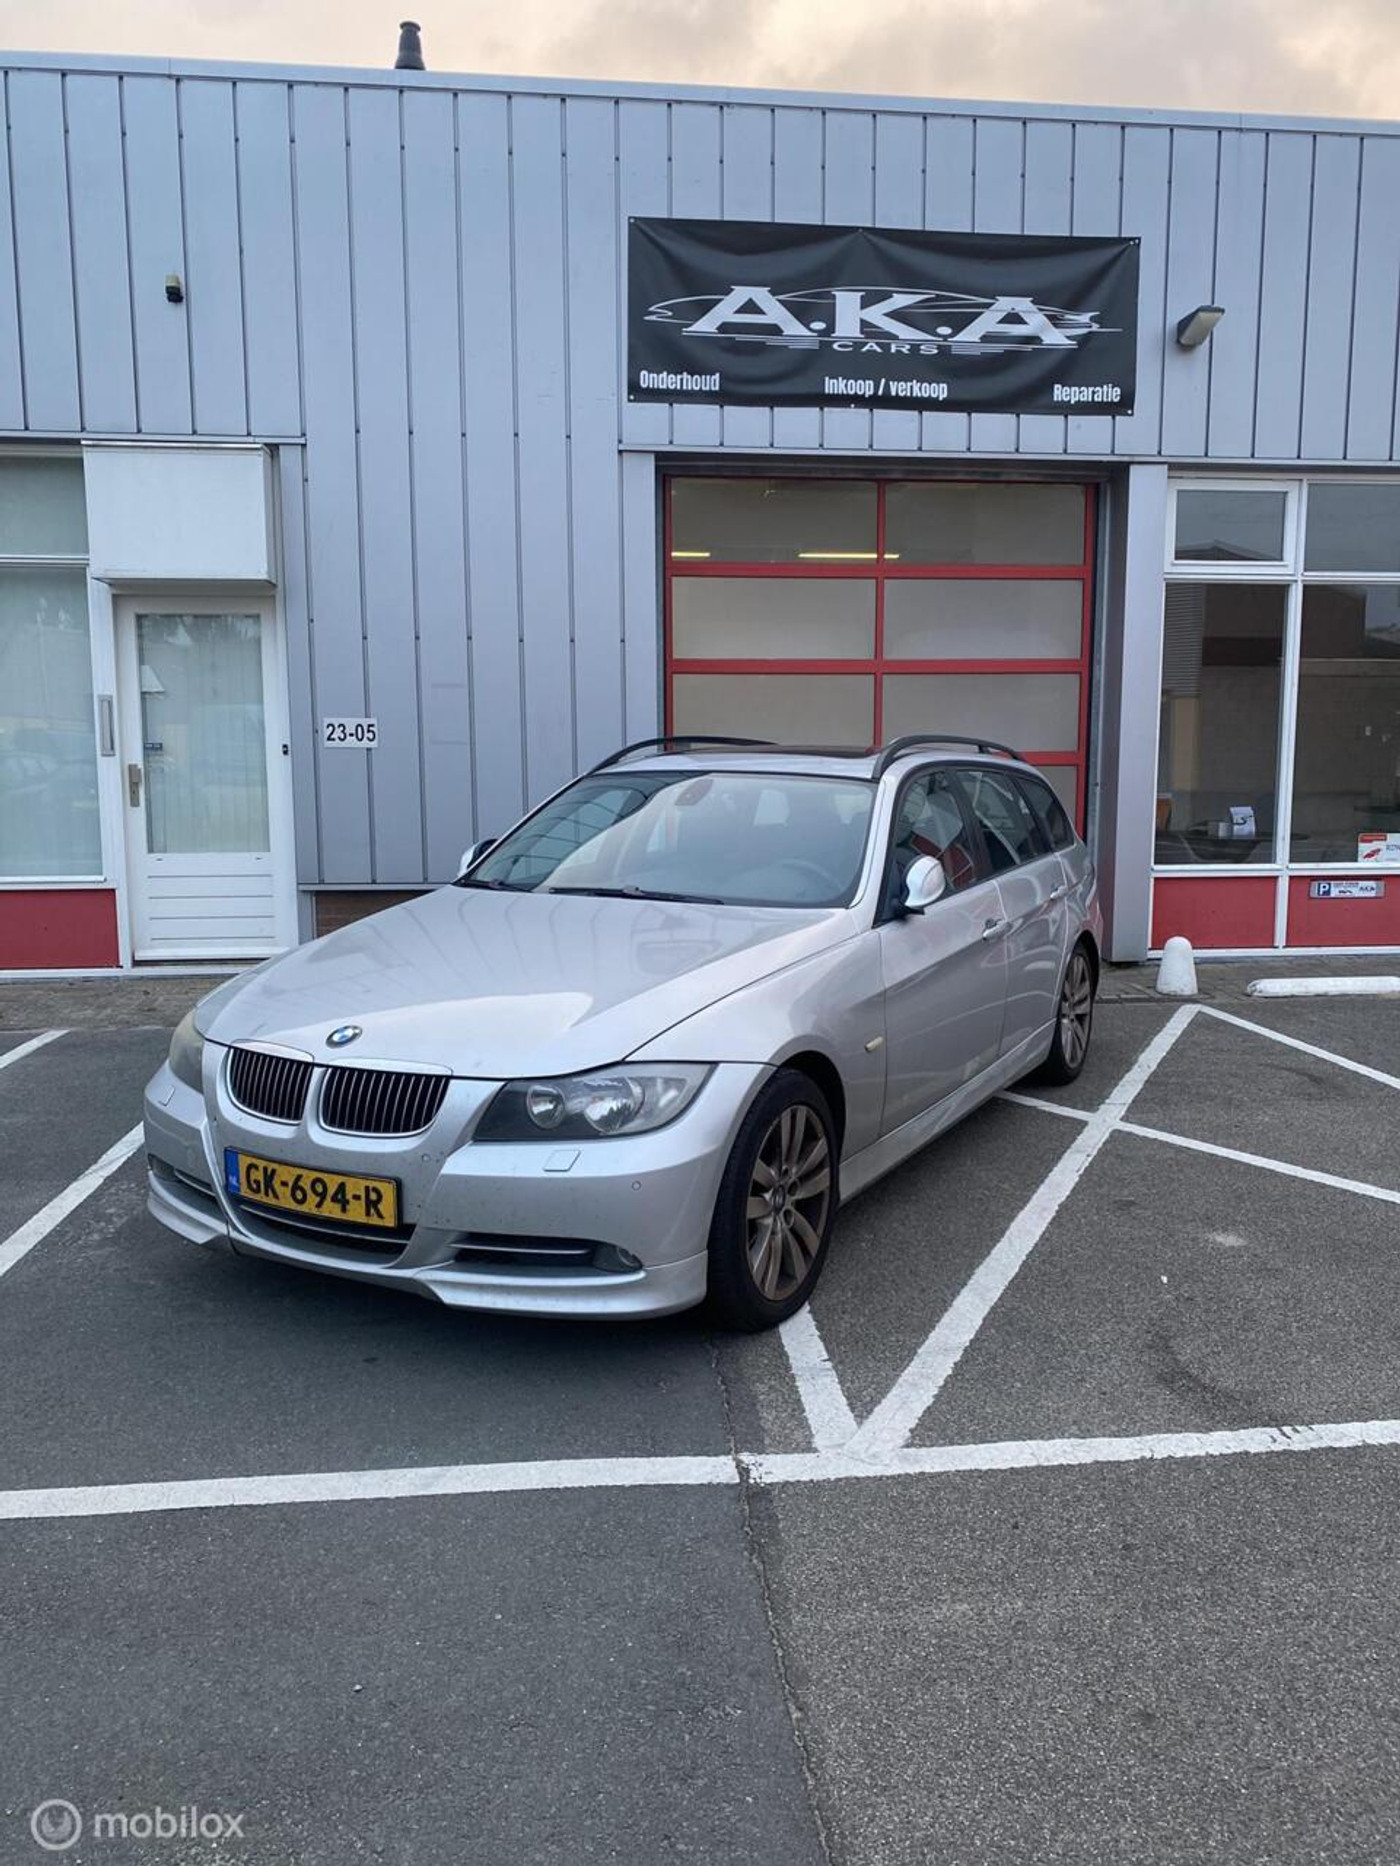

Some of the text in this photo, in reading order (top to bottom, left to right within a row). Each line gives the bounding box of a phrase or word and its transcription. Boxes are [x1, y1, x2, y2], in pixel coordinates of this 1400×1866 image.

[832, 341, 939, 355] CARS
[639, 370, 720, 391] Onderhoud
[824, 376, 948, 401] Inkoop / verkoop
[1053, 383, 1121, 404] Reparatie
[326, 723, 376, 742] 23-05
[245, 1162, 386, 1221] GK-694-R
